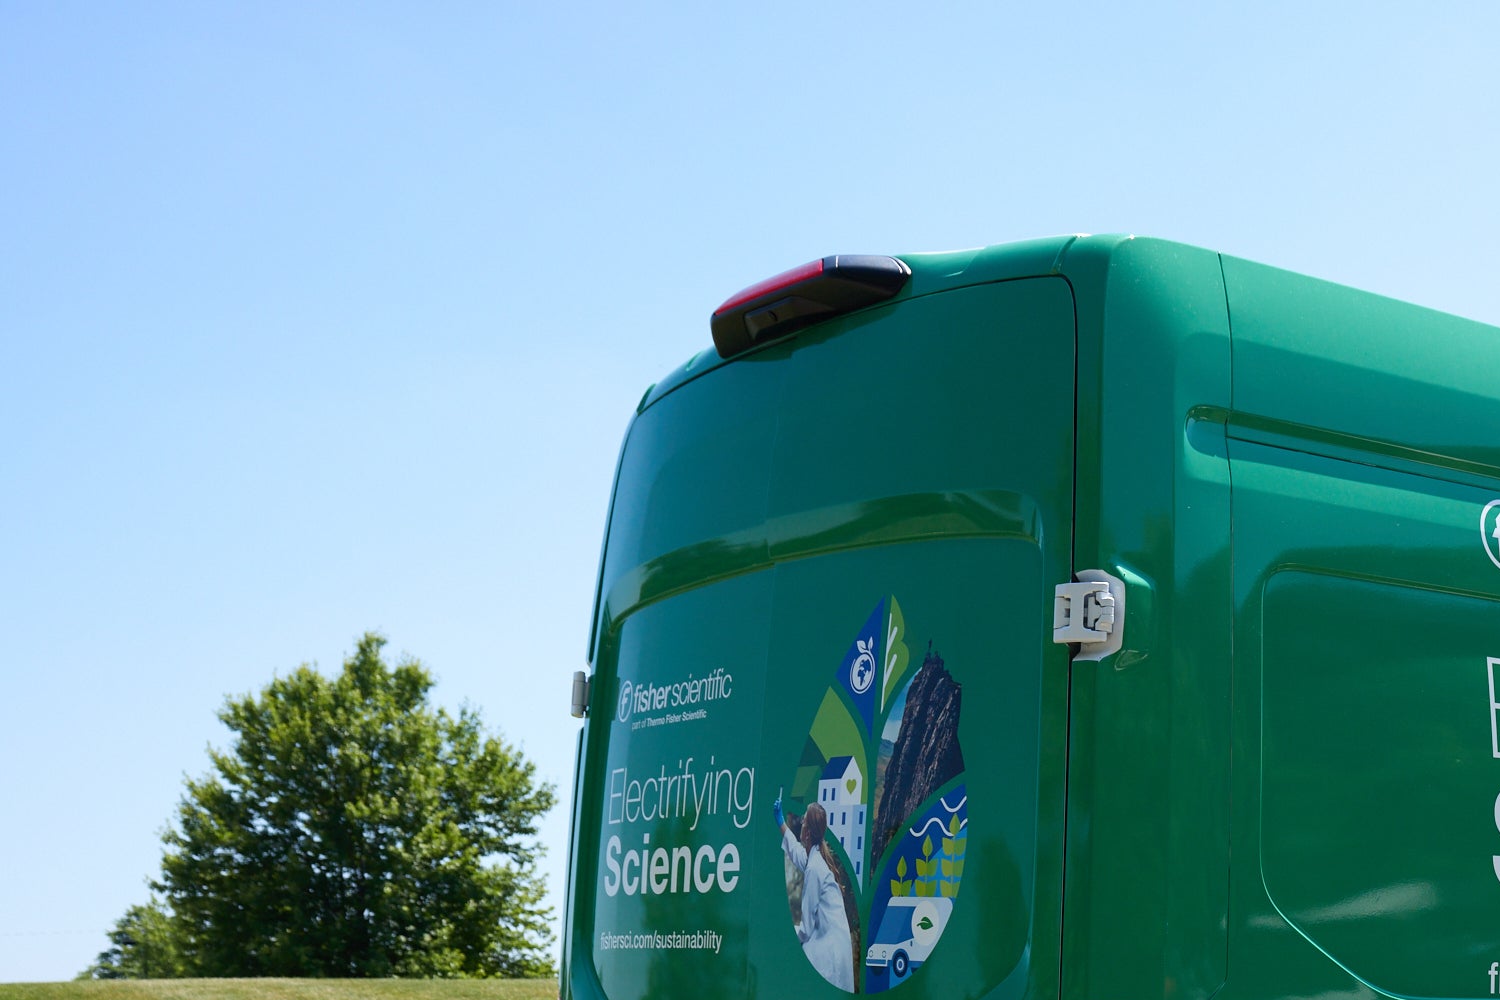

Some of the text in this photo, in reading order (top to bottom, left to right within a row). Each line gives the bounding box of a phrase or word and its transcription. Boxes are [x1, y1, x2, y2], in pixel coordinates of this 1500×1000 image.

[633, 681, 672, 714] fisher
[671, 667, 733, 707] scientific
[646, 717, 666, 727] Thermo
[665, 714, 681, 724] Fisher
[682, 709, 707, 722] Scientific
[607, 755, 755, 832] Electrifying
[603, 832, 741, 897] Science
[600, 929, 723, 954] fishersci.com/sustainability
